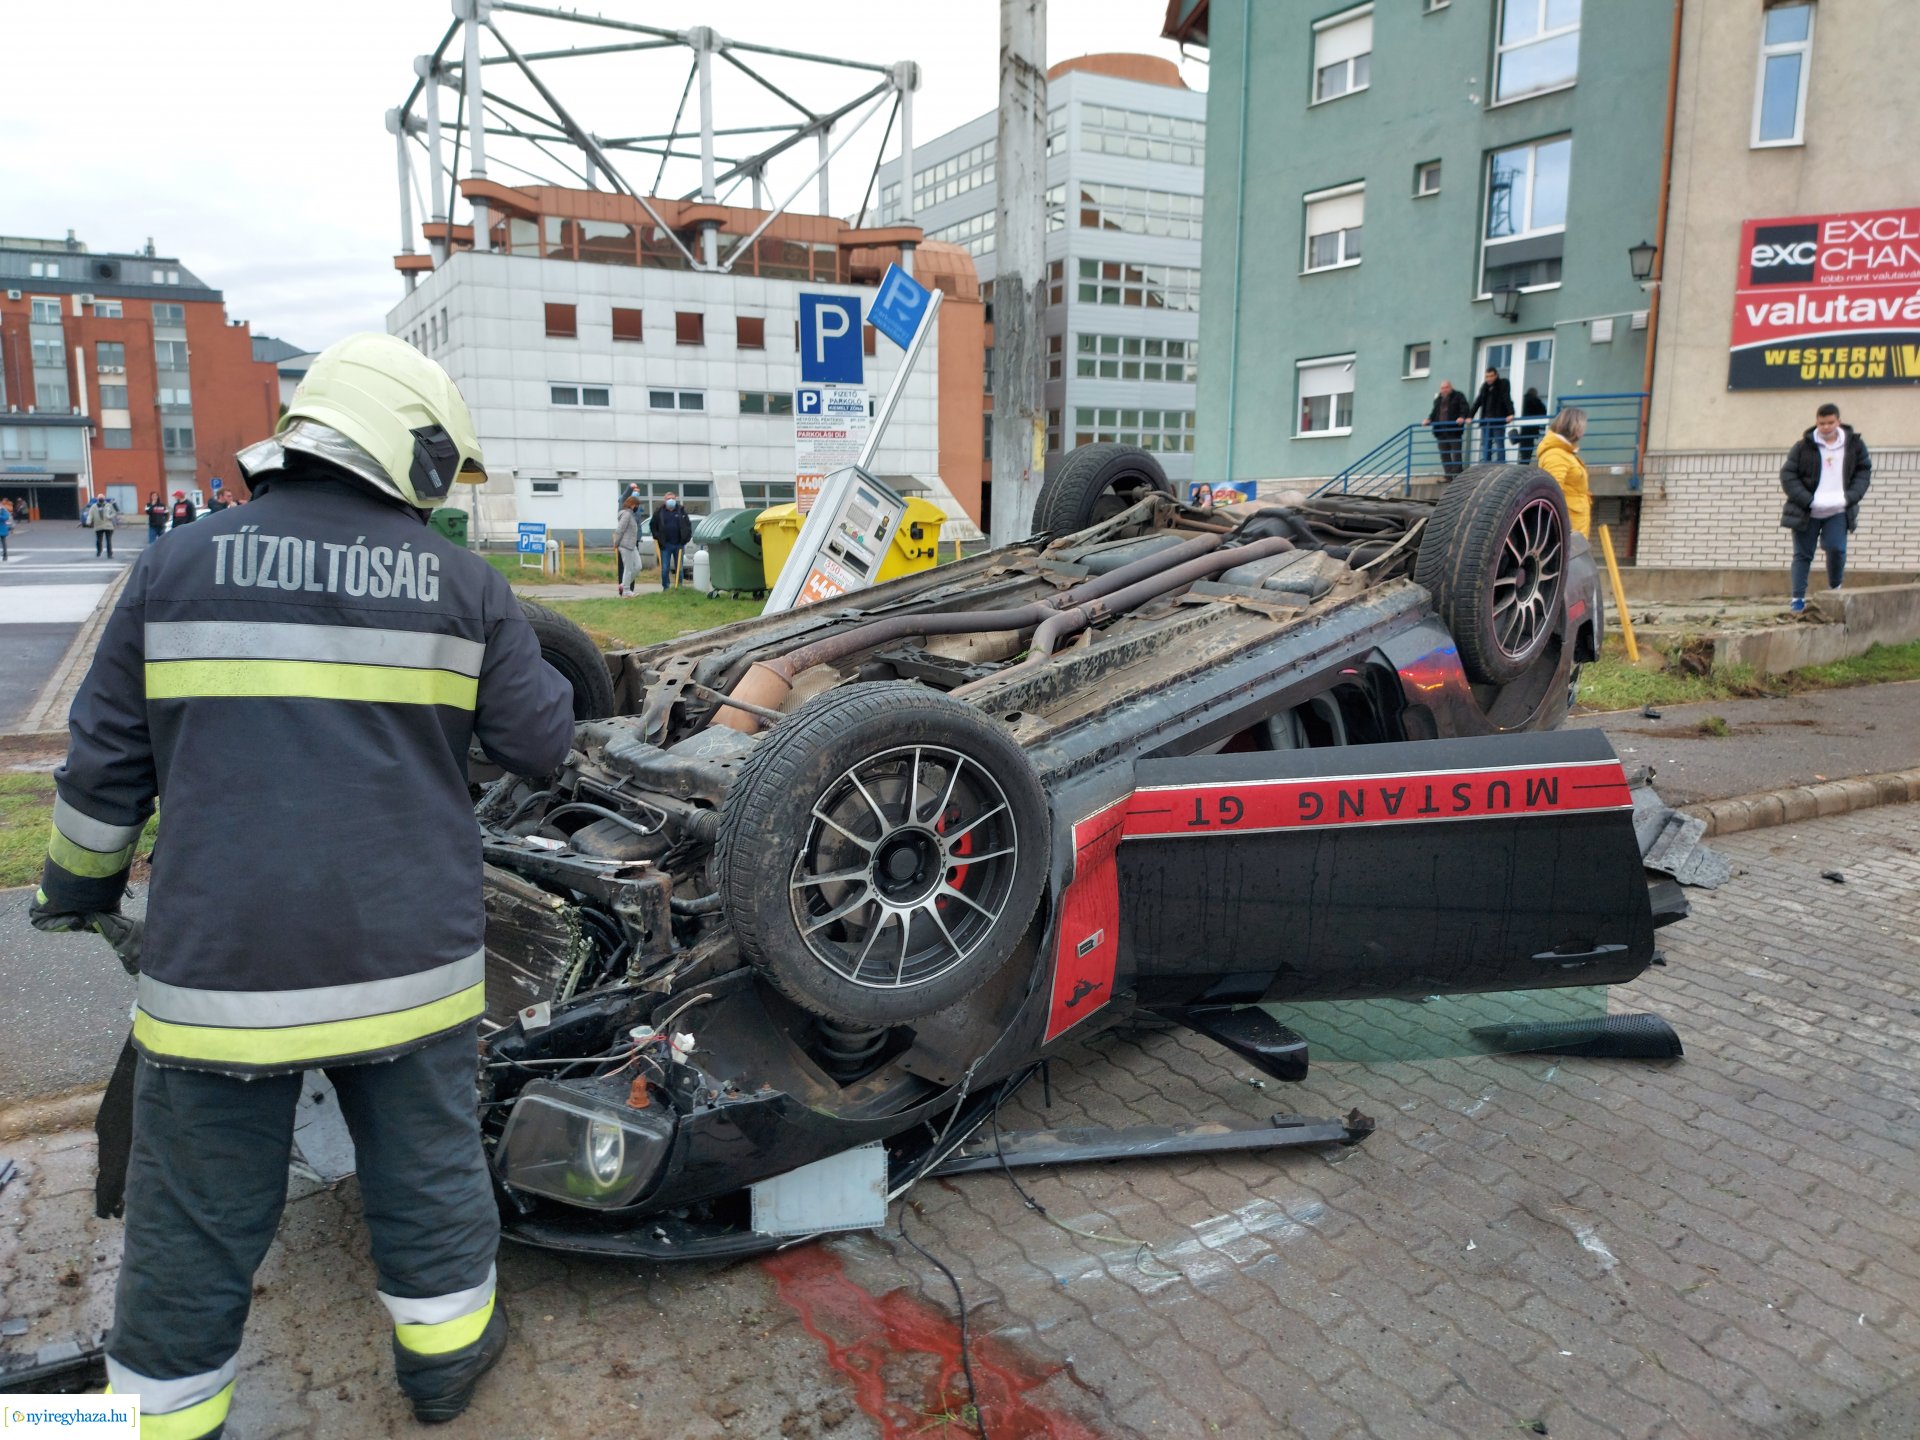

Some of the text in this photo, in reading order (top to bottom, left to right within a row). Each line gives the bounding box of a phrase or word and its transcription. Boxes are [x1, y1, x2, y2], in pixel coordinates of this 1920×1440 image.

[1823, 216, 1920, 244] EXCL
[1751, 241, 1817, 267] exc
[1821, 244, 1920, 271] CHAN
[1846, 273, 1870, 281] mint
[882, 272, 921, 310] P
[815, 303, 850, 363] P
[1764, 346, 1887, 365] WESTERN
[1800, 363, 1885, 380] UNION
[802, 391, 818, 412] P
[212, 525, 440, 602] TŰZOLTÓSÁG
[810, 574, 843, 598] 440
[1187, 775, 1560, 826] MUSTANG GT
